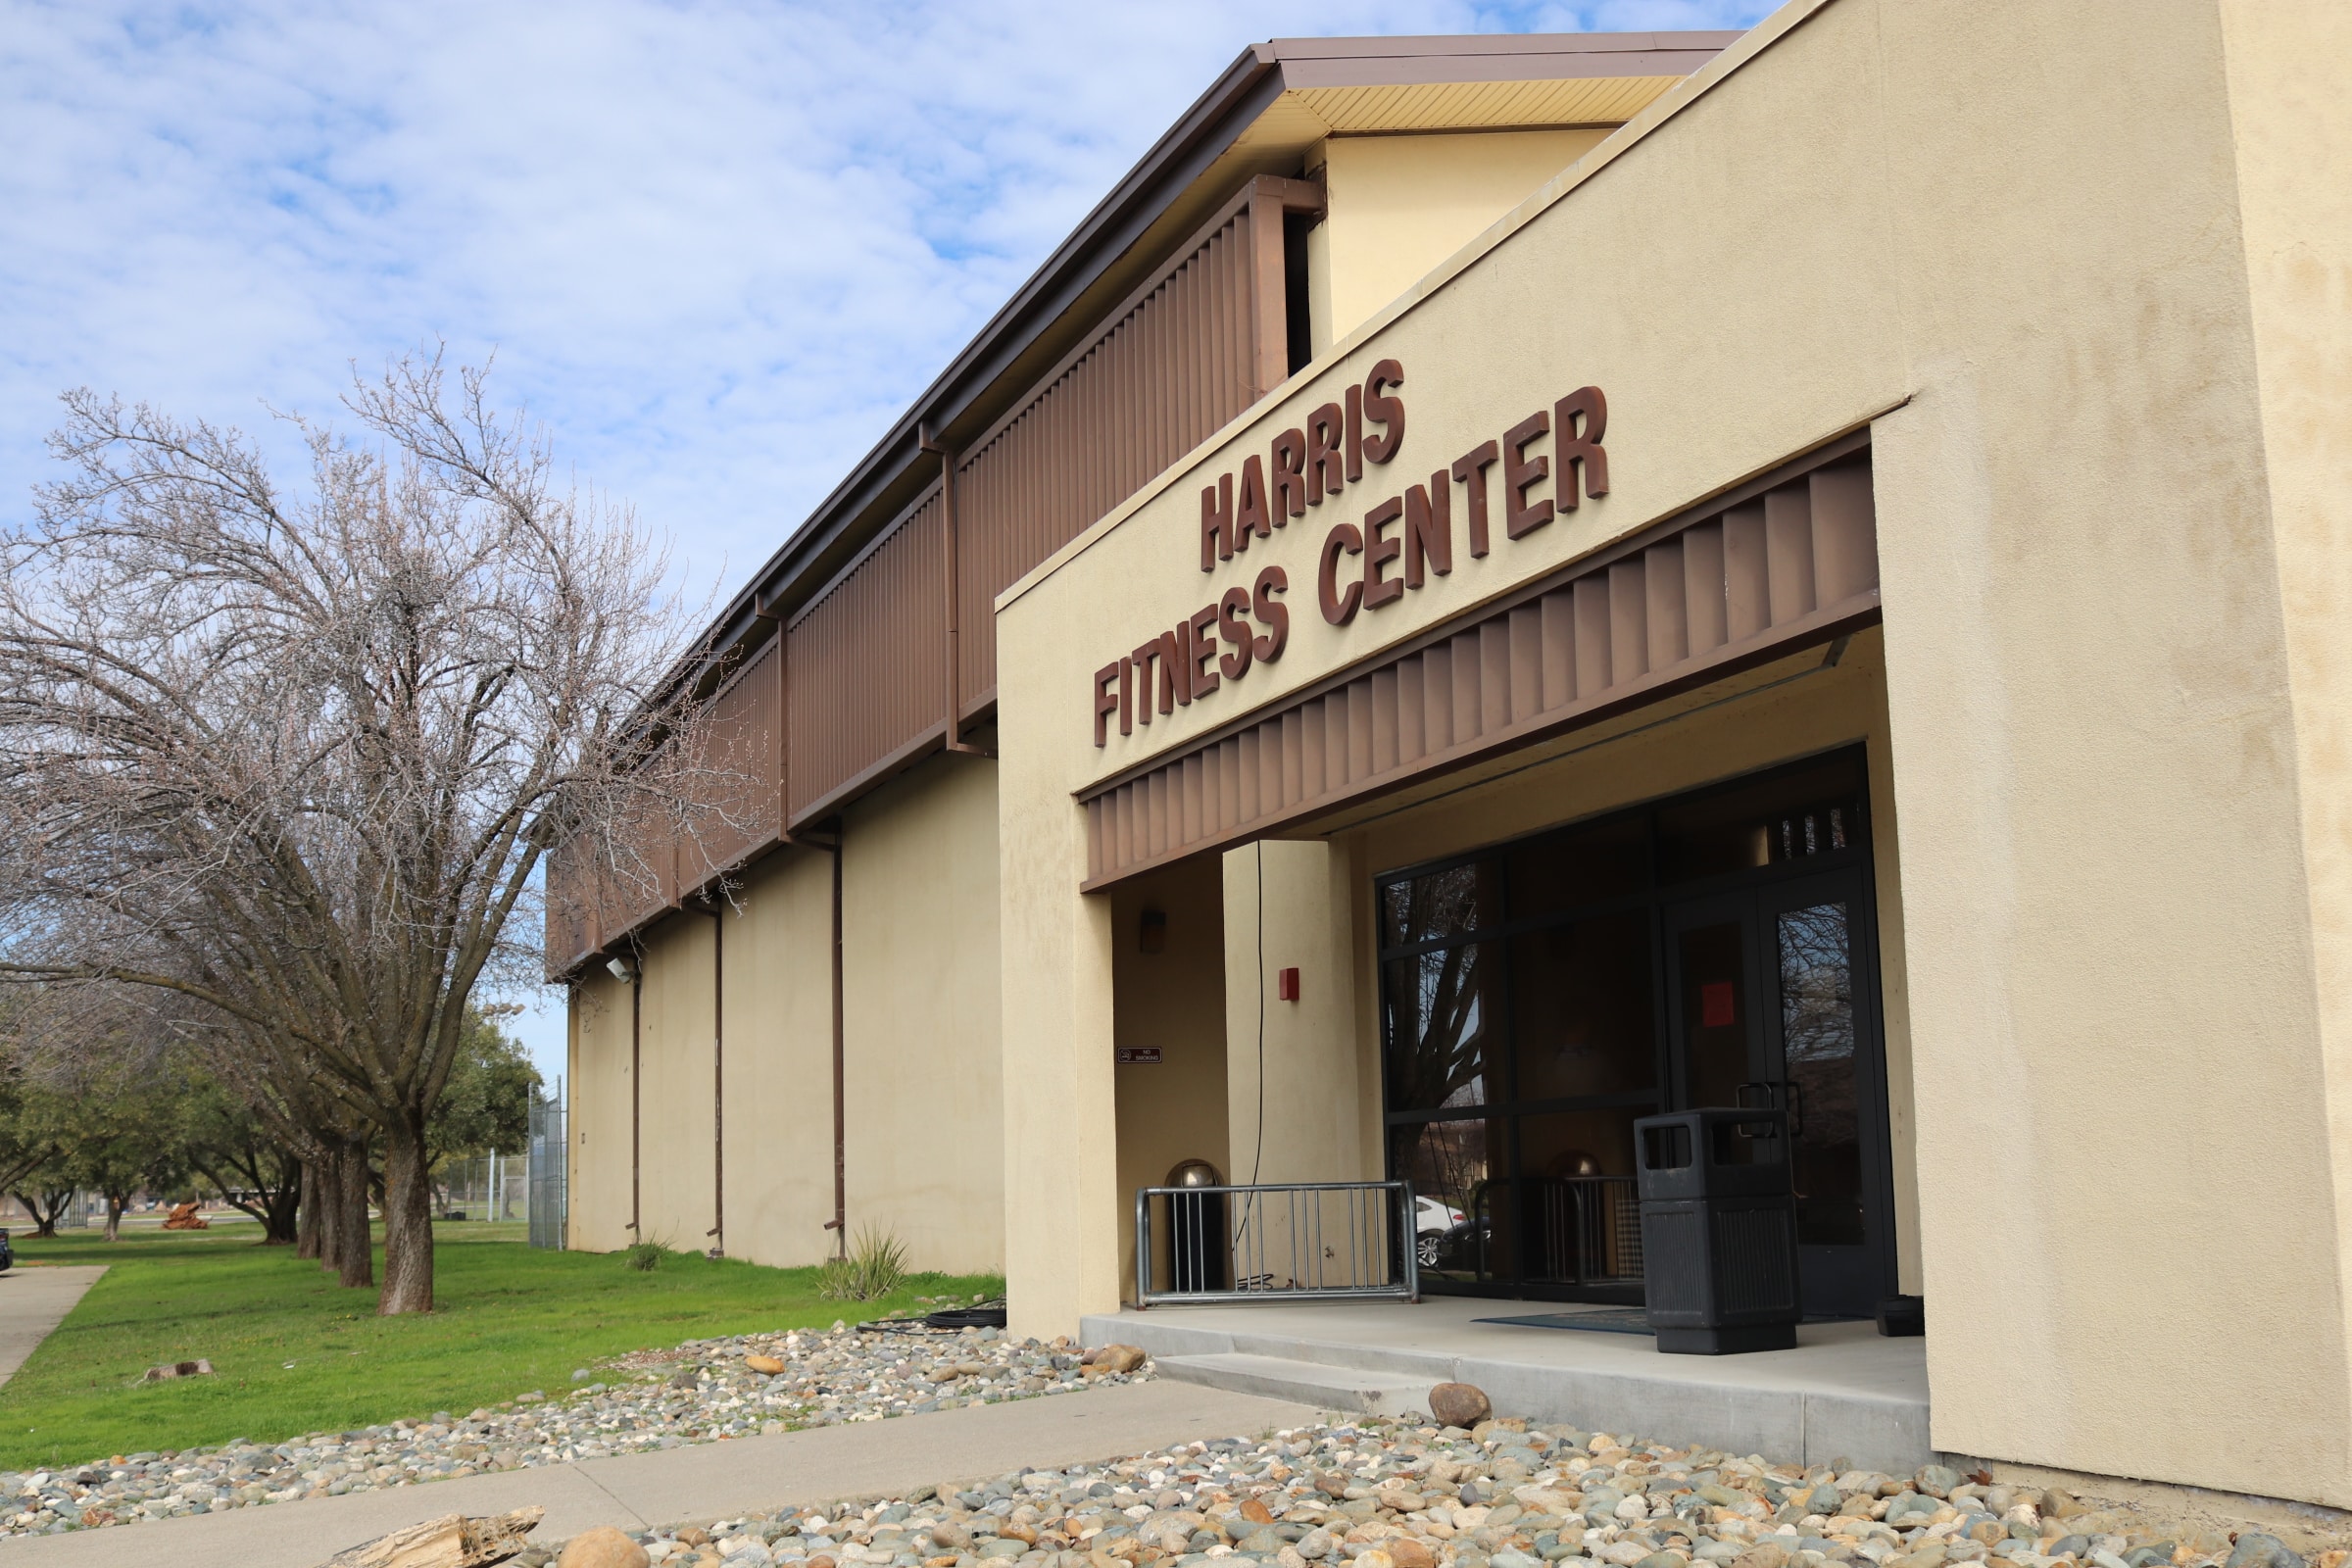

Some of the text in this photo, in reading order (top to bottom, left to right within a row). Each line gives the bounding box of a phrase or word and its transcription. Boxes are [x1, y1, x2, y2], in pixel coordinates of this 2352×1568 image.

[1094, 385, 1609, 748] FITNESS CENTER
[1200, 359, 1404, 572] HARRIS
